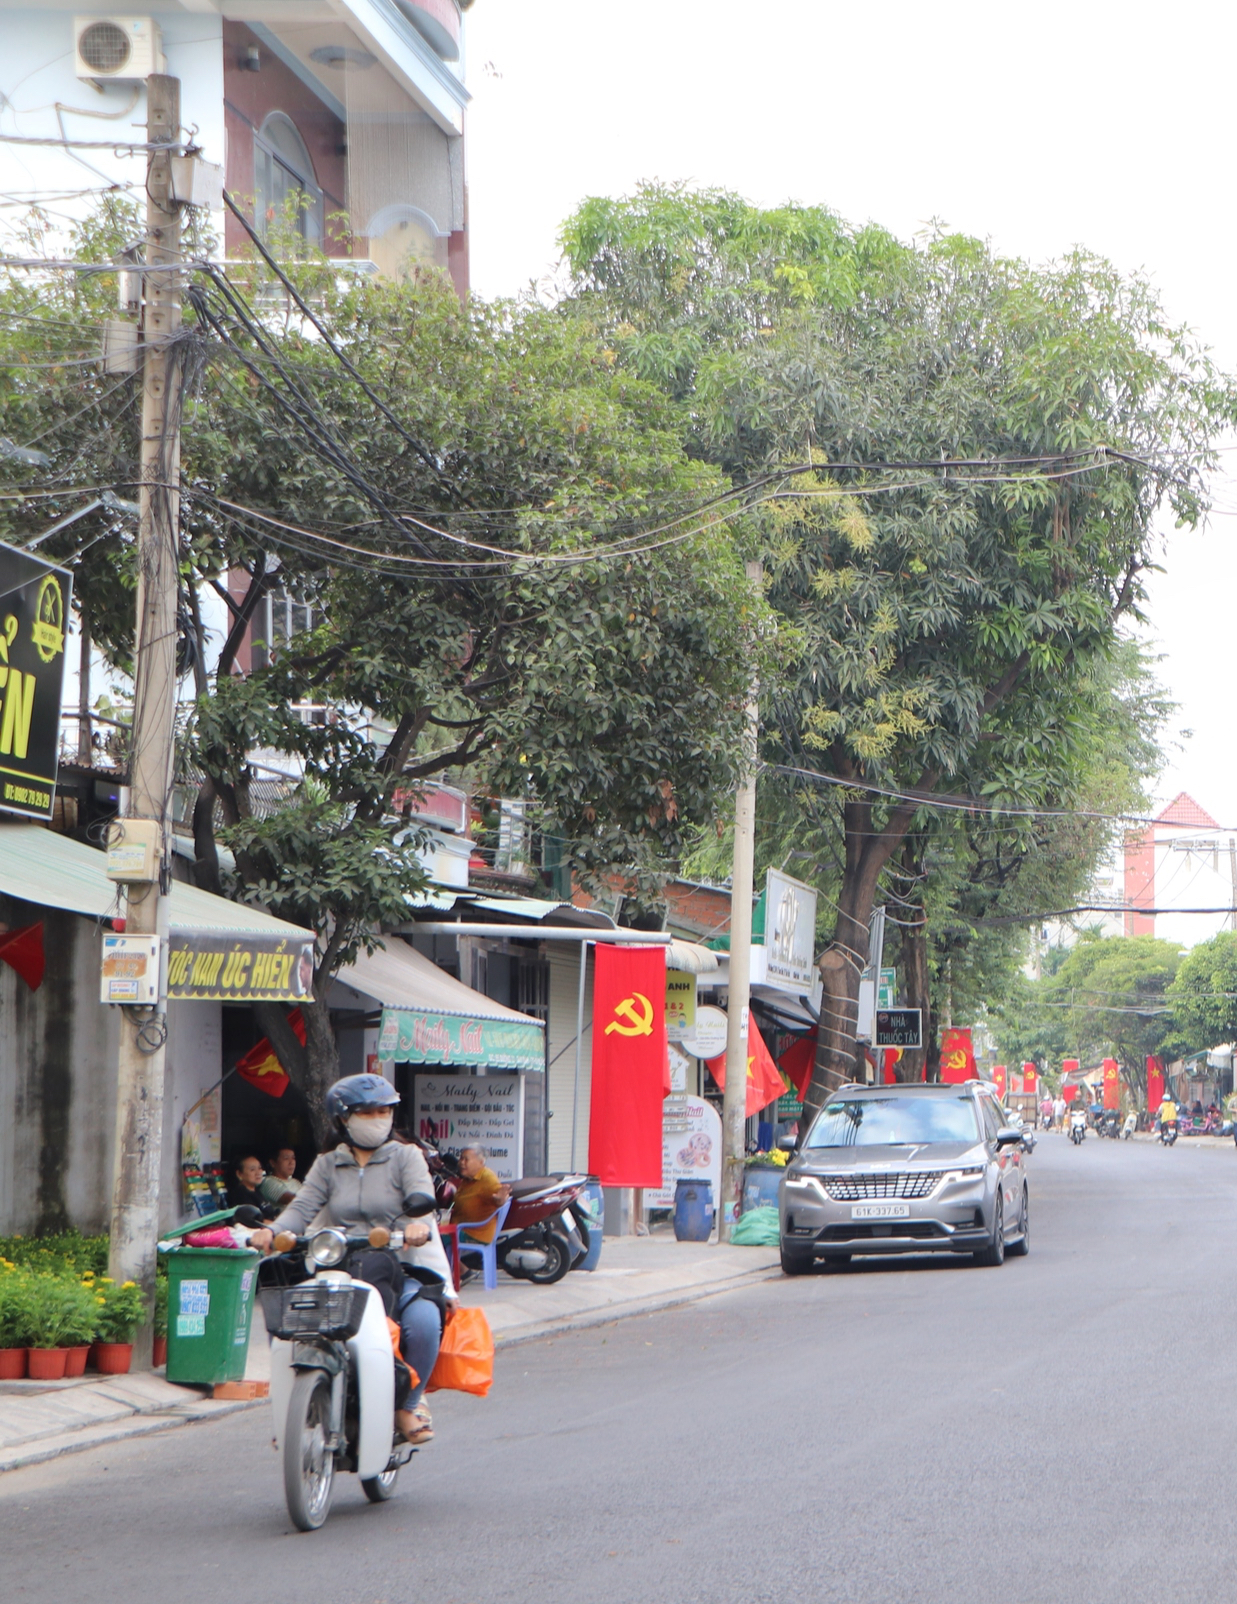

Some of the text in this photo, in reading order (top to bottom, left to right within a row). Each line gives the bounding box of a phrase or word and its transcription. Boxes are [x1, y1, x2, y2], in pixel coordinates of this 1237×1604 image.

[168, 944, 193, 986] TÓC
[189, 951, 225, 987] NAM
[221, 944, 252, 989] ÚC
[667, 982, 690, 991] ANH
[891, 1013, 906, 1028] NHÀ
[453, 1019, 484, 1055] Nail
[880, 1028, 918, 1044] THUỐC TÂY
[434, 1083, 515, 1103] Maily Nail
[856, 1206, 905, 1217] 61K-337.65
